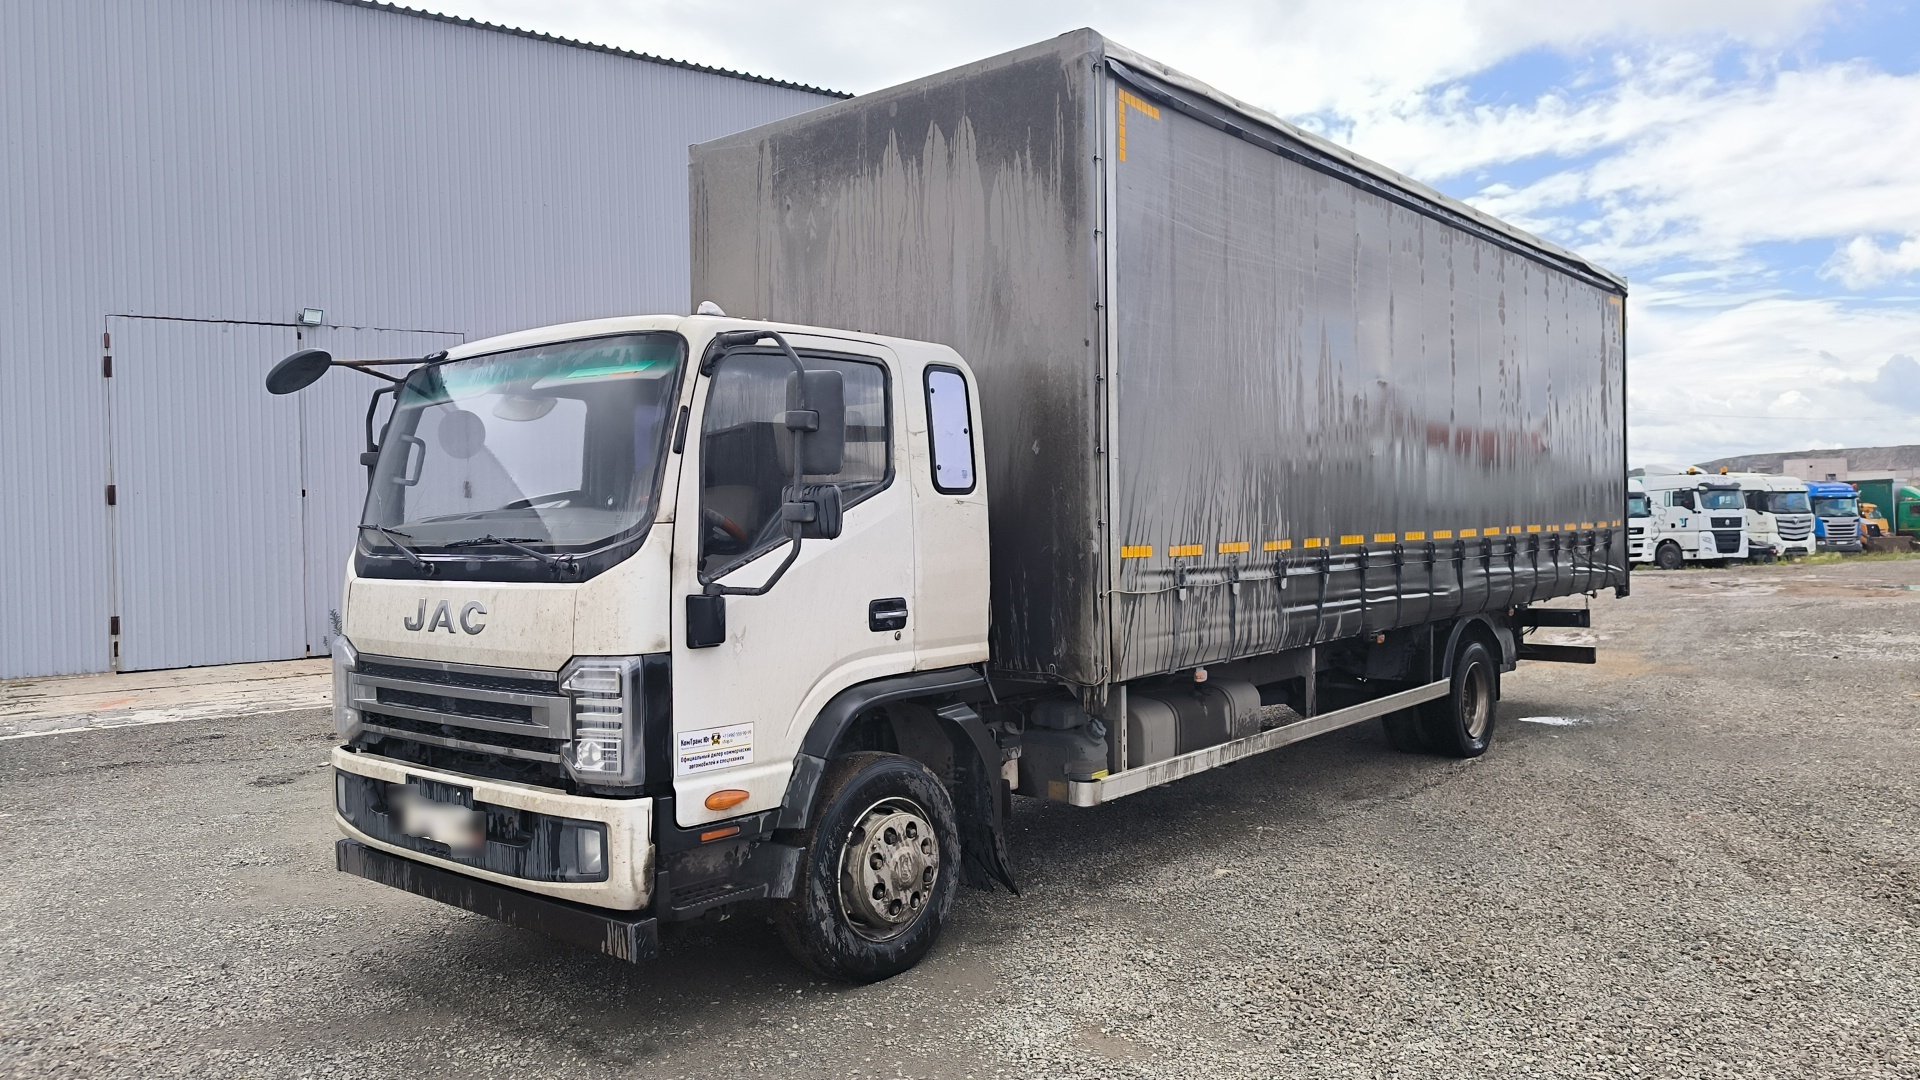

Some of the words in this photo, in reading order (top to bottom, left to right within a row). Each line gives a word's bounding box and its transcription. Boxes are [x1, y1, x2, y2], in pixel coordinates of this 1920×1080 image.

[404, 597, 487, 635] JAC
[681, 754, 710, 763] Официальный
[689, 761, 716, 769] автомобилей
